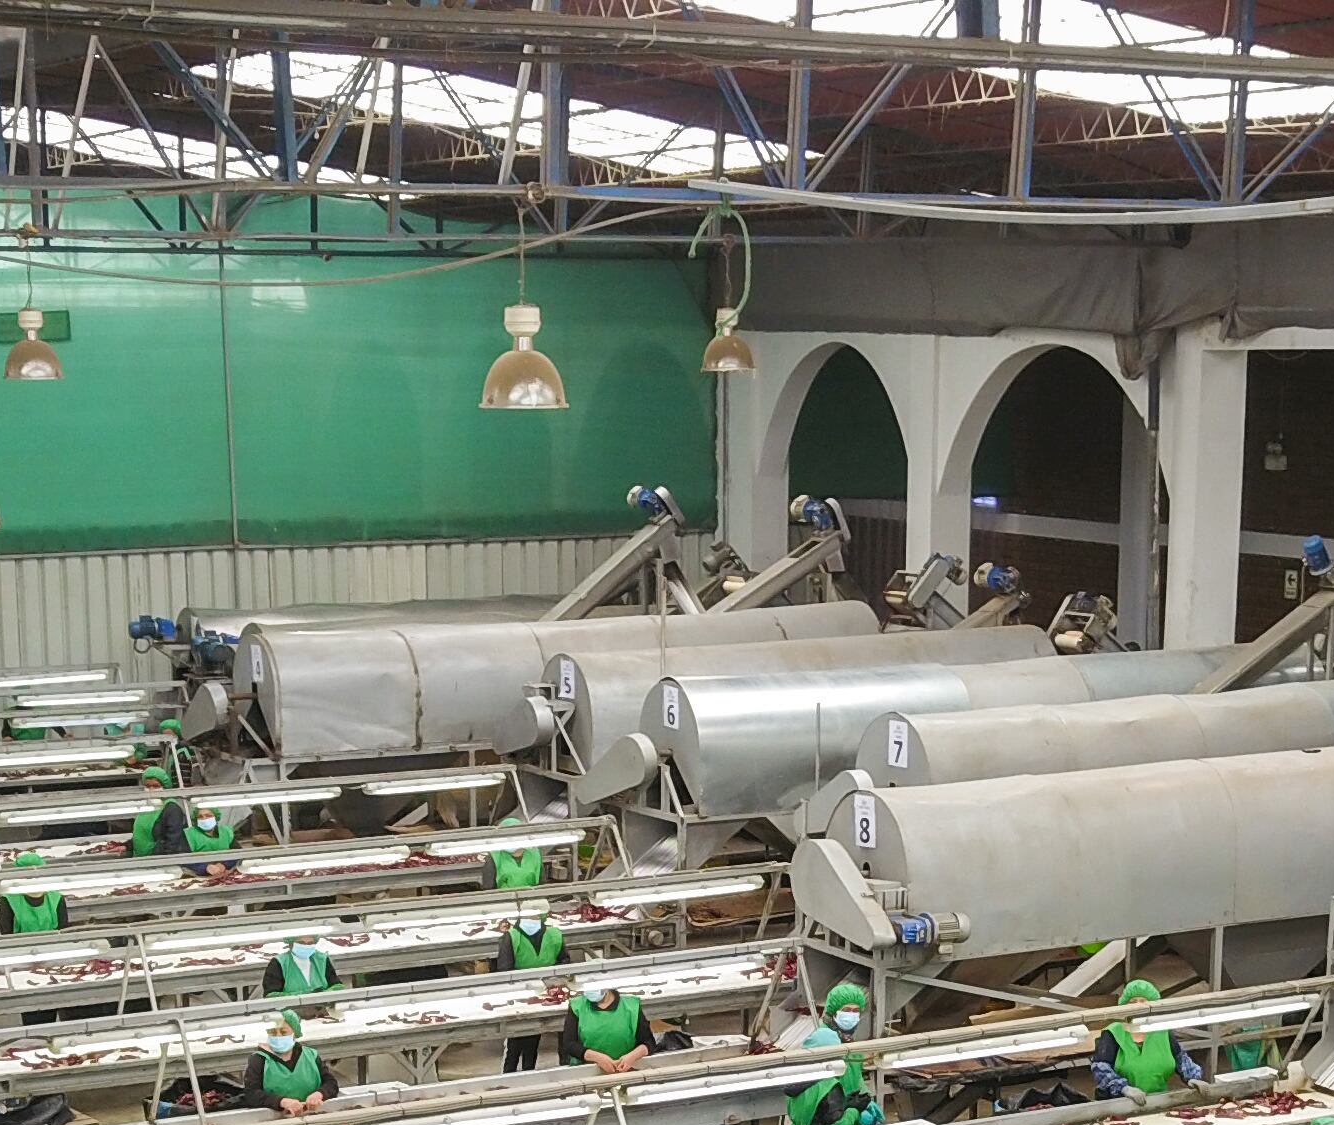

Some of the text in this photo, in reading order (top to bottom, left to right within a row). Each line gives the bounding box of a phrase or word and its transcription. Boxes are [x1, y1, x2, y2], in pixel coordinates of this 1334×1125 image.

[564, 677, 572, 694] 5
[667, 705, 675, 725] 6
[894, 741, 903, 763] 7
[860, 818, 870, 843] 8
